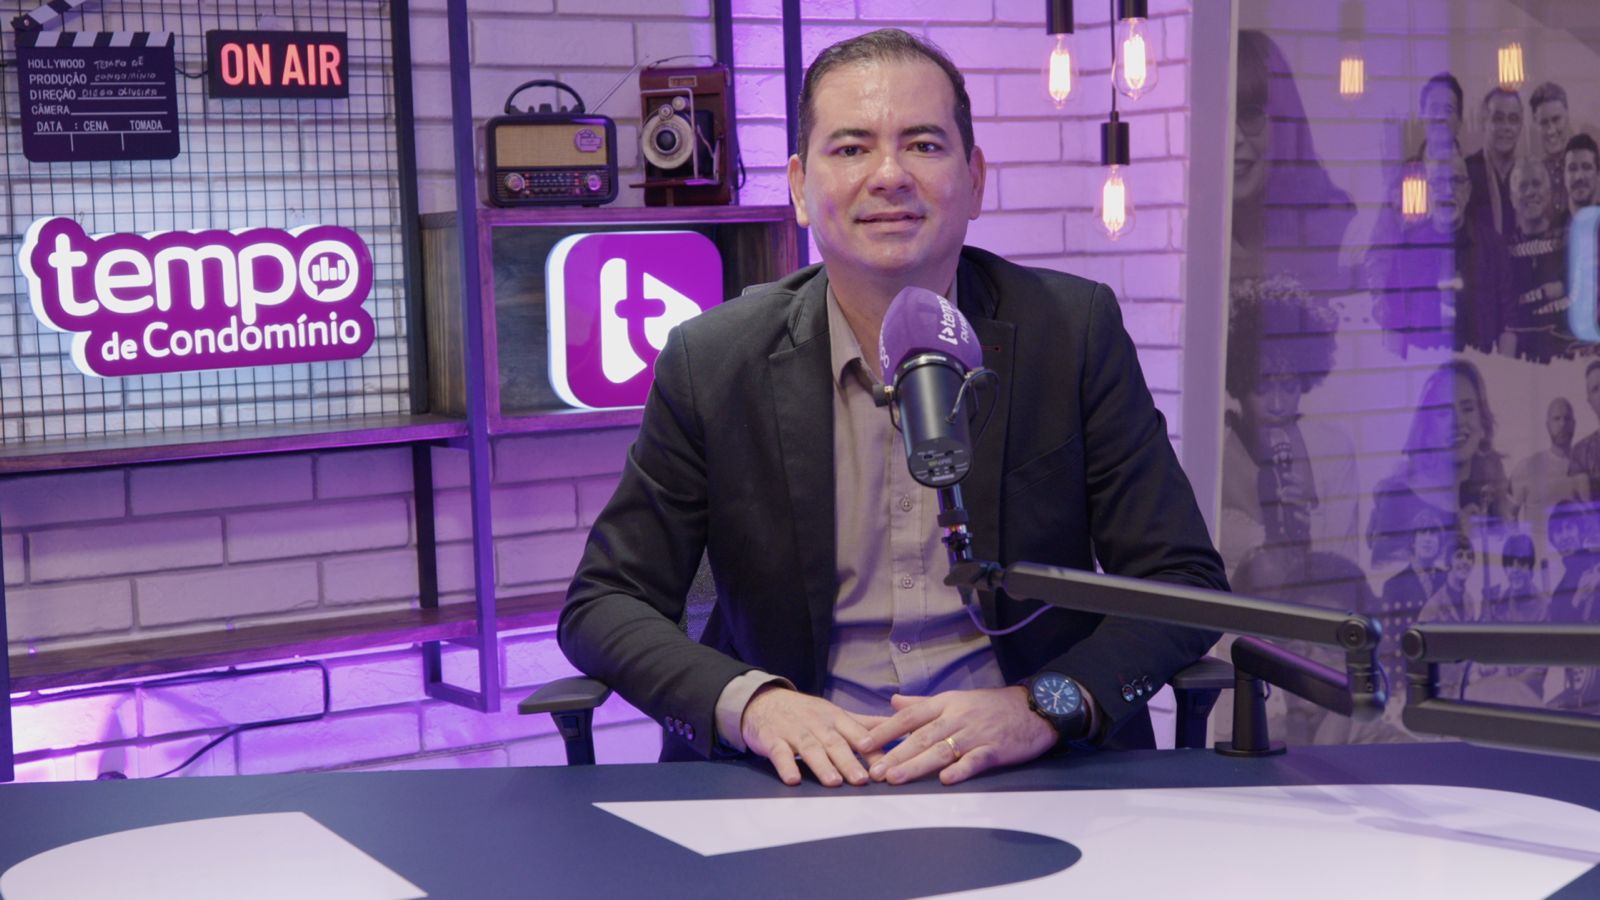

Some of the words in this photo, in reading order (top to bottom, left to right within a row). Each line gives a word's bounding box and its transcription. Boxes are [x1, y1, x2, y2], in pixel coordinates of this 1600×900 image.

[28, 58, 85, 69] HOLLYWOOD
[221, 42, 272, 86] ON
[281, 43, 342, 86] AIR
[29, 72, 87, 86] PRODUÇÃO
[30, 87, 76, 102] DIREÇÃO
[31, 103, 70, 115] CÂMERA
[37, 121, 63, 132] DATA
[83, 120, 109, 131] CENA
[130, 120, 163, 131] TOMADA
[47, 233, 359, 326] tempo
[101, 332, 138, 362] de
[142, 311, 361, 358] Condomínio
